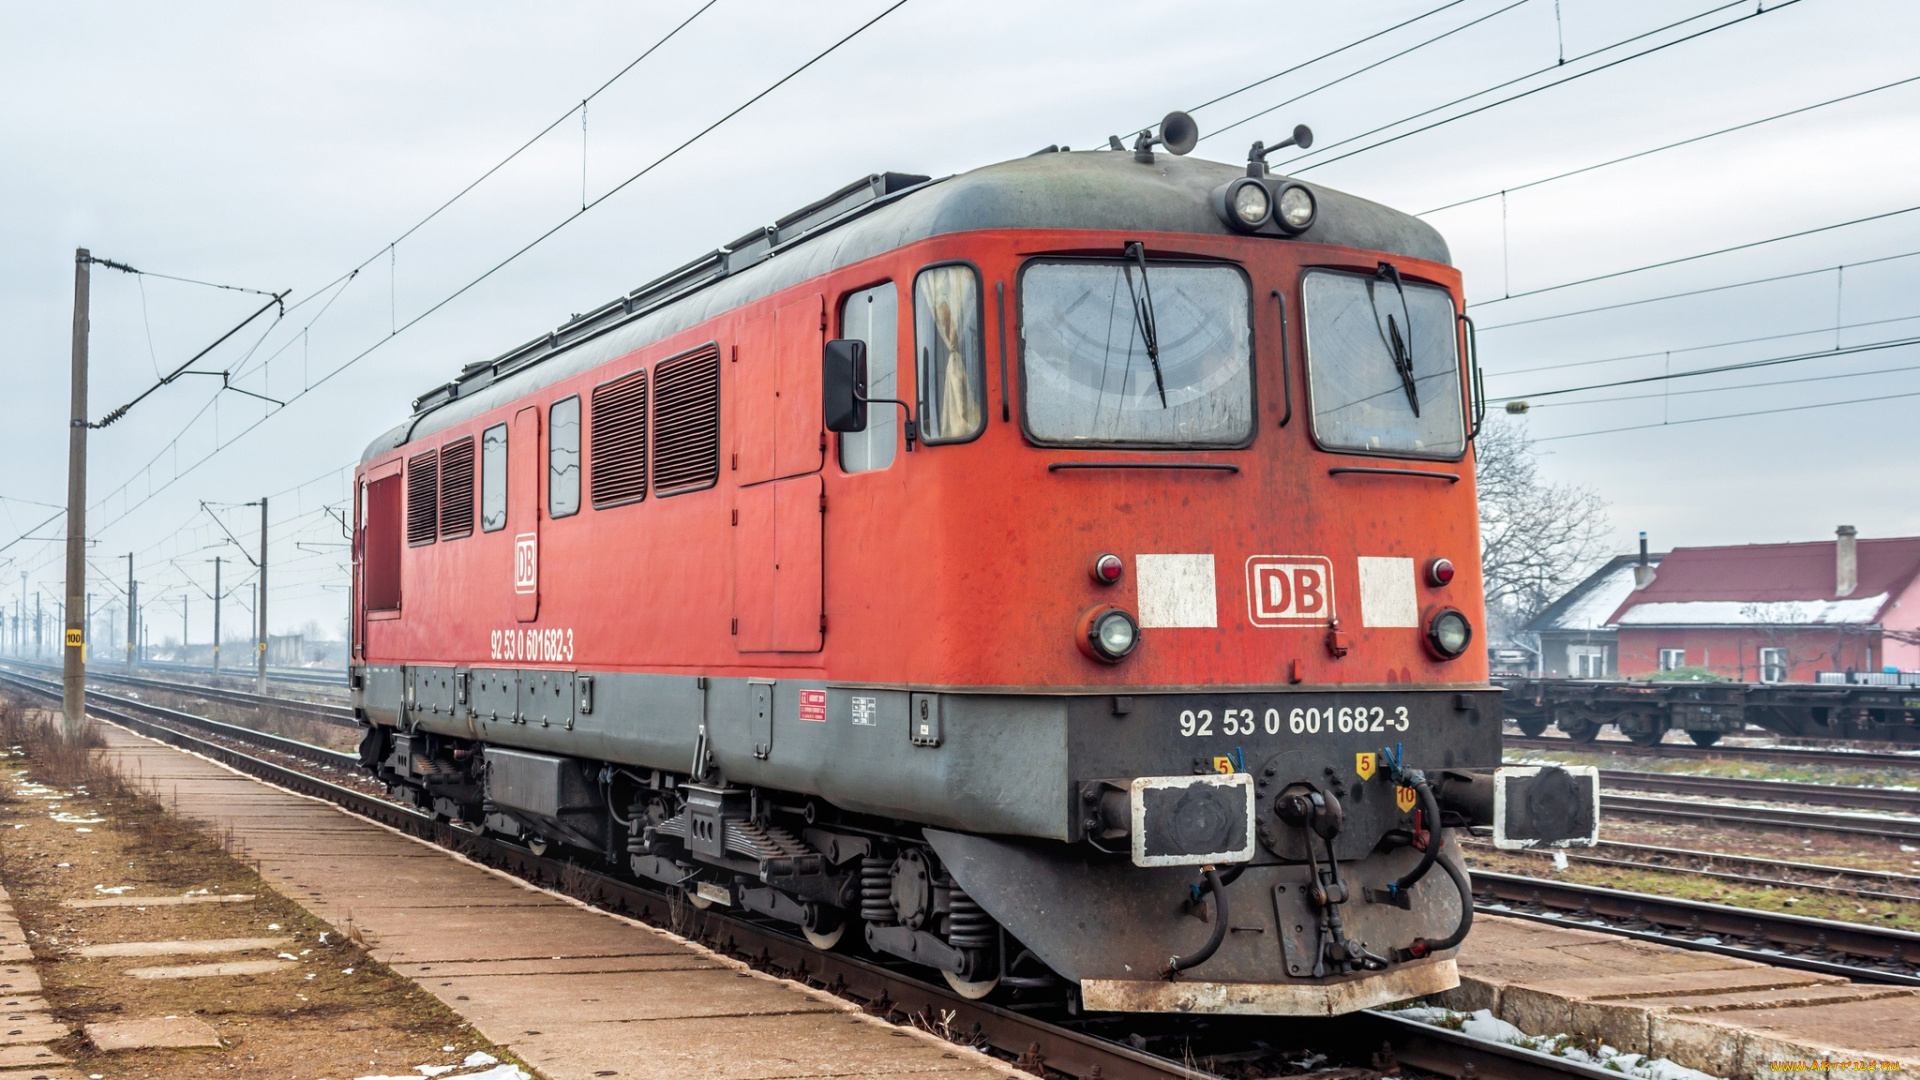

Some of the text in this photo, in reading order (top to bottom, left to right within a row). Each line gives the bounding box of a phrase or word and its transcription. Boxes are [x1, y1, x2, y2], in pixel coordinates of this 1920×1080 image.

[517, 543, 534, 583] DB
[1258, 567, 1325, 615] DB
[67, 633, 81, 643] 100
[491, 627, 574, 662] 92 53 0 601682-3
[1179, 706, 1410, 737] 92 53 0 601682-3
[1219, 759, 1229, 774] 5
[1360, 755, 1371, 772] 5
[1397, 786, 1415, 803] 10
